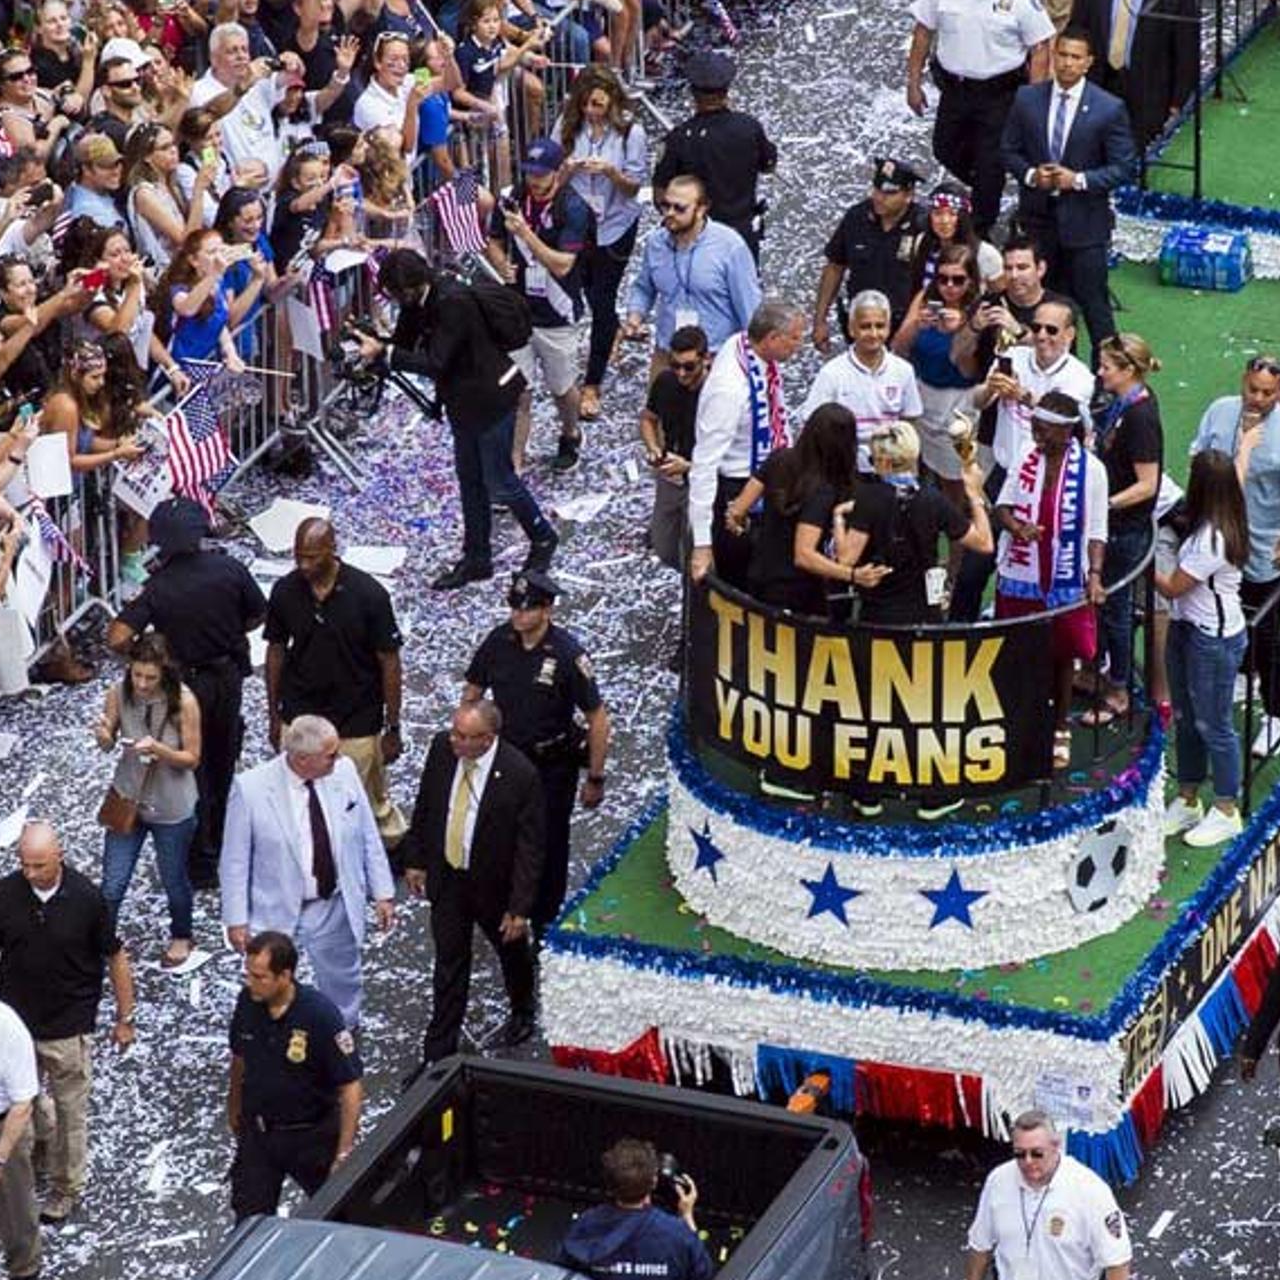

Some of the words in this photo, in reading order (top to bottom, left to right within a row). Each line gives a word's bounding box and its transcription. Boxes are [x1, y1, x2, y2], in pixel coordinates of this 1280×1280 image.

[708, 591, 1006, 723] THANK
[715, 679, 813, 771] YOU
[832, 709, 1008, 786] FANS
[1200, 894, 1243, 983] ONE
